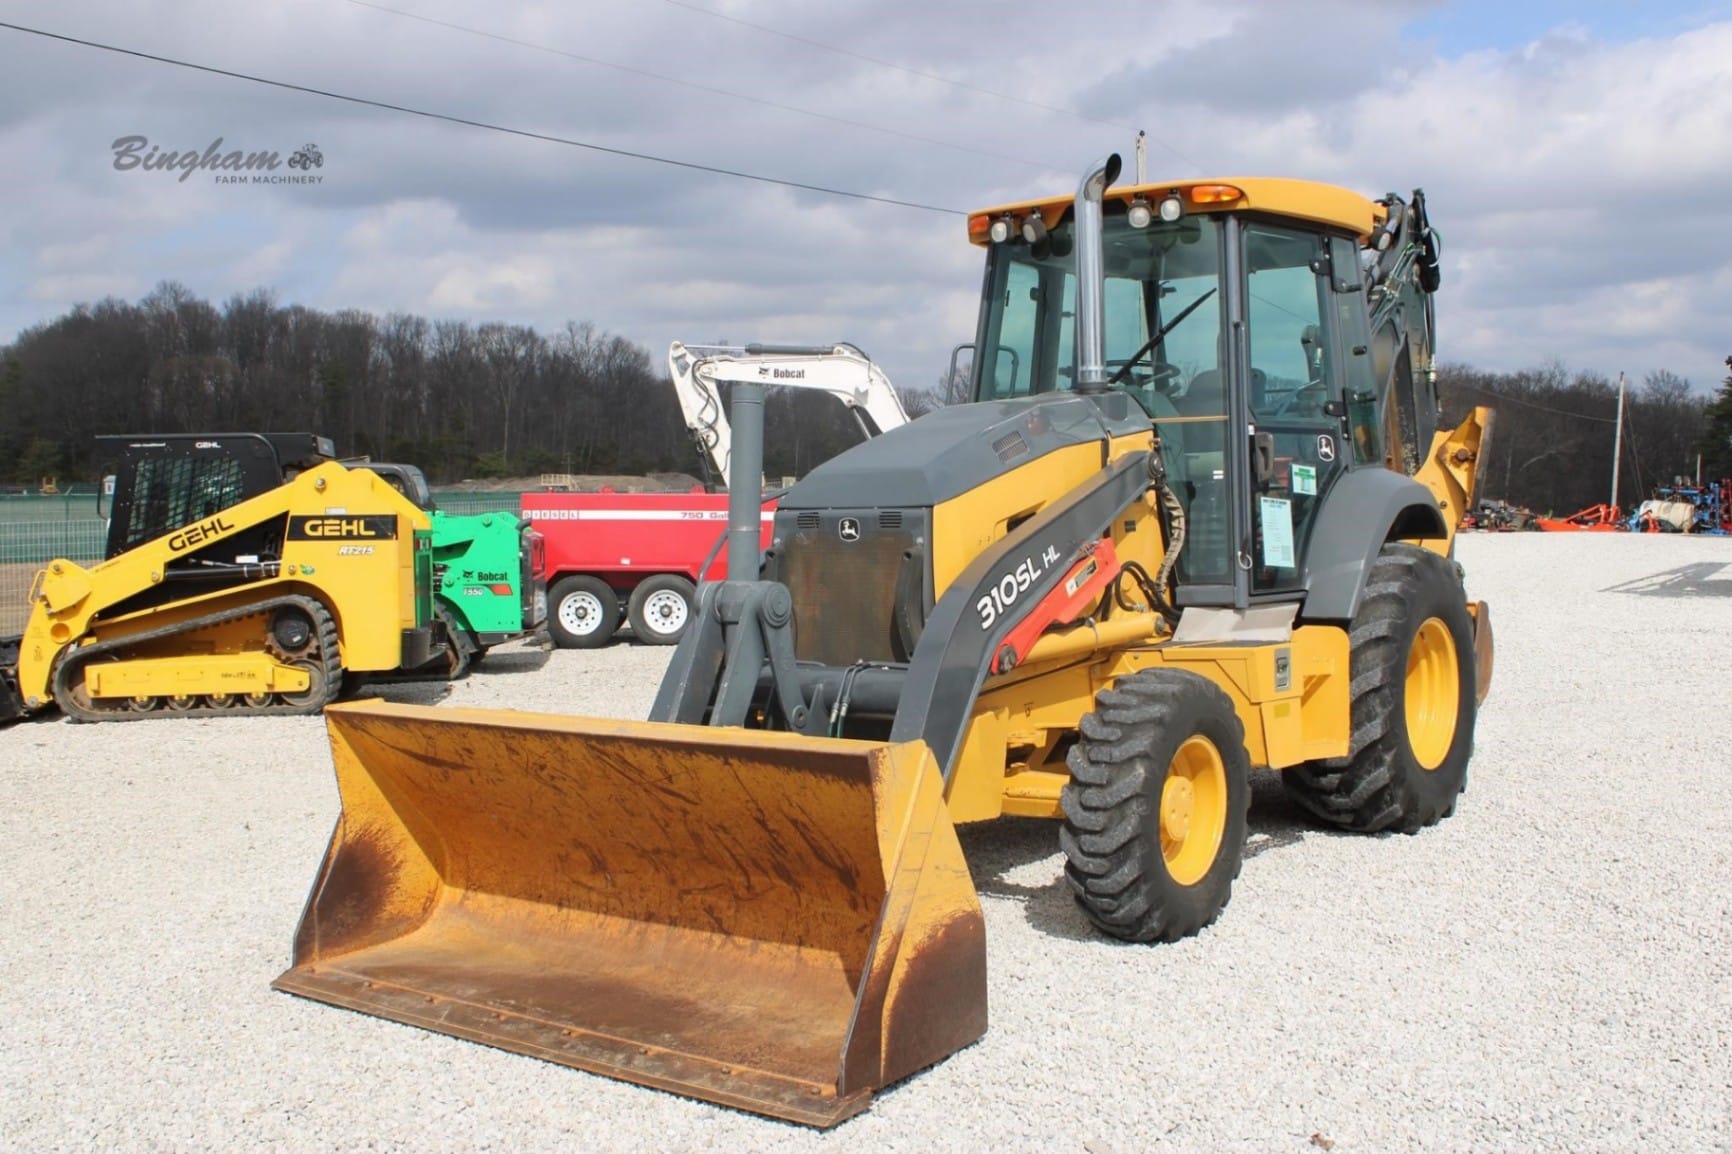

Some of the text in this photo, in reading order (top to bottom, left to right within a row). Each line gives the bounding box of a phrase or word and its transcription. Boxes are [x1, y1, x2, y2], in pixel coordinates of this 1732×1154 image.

[773, 368, 805, 379] Bobcat
[523, 511, 578, 519] DIESEL
[680, 511, 704, 519] 750
[304, 518, 376, 536] GEHL
[168, 517, 234, 551] GEHL
[477, 571, 508, 581] Bobcat
[976, 544, 1061, 630] 310SL HL
